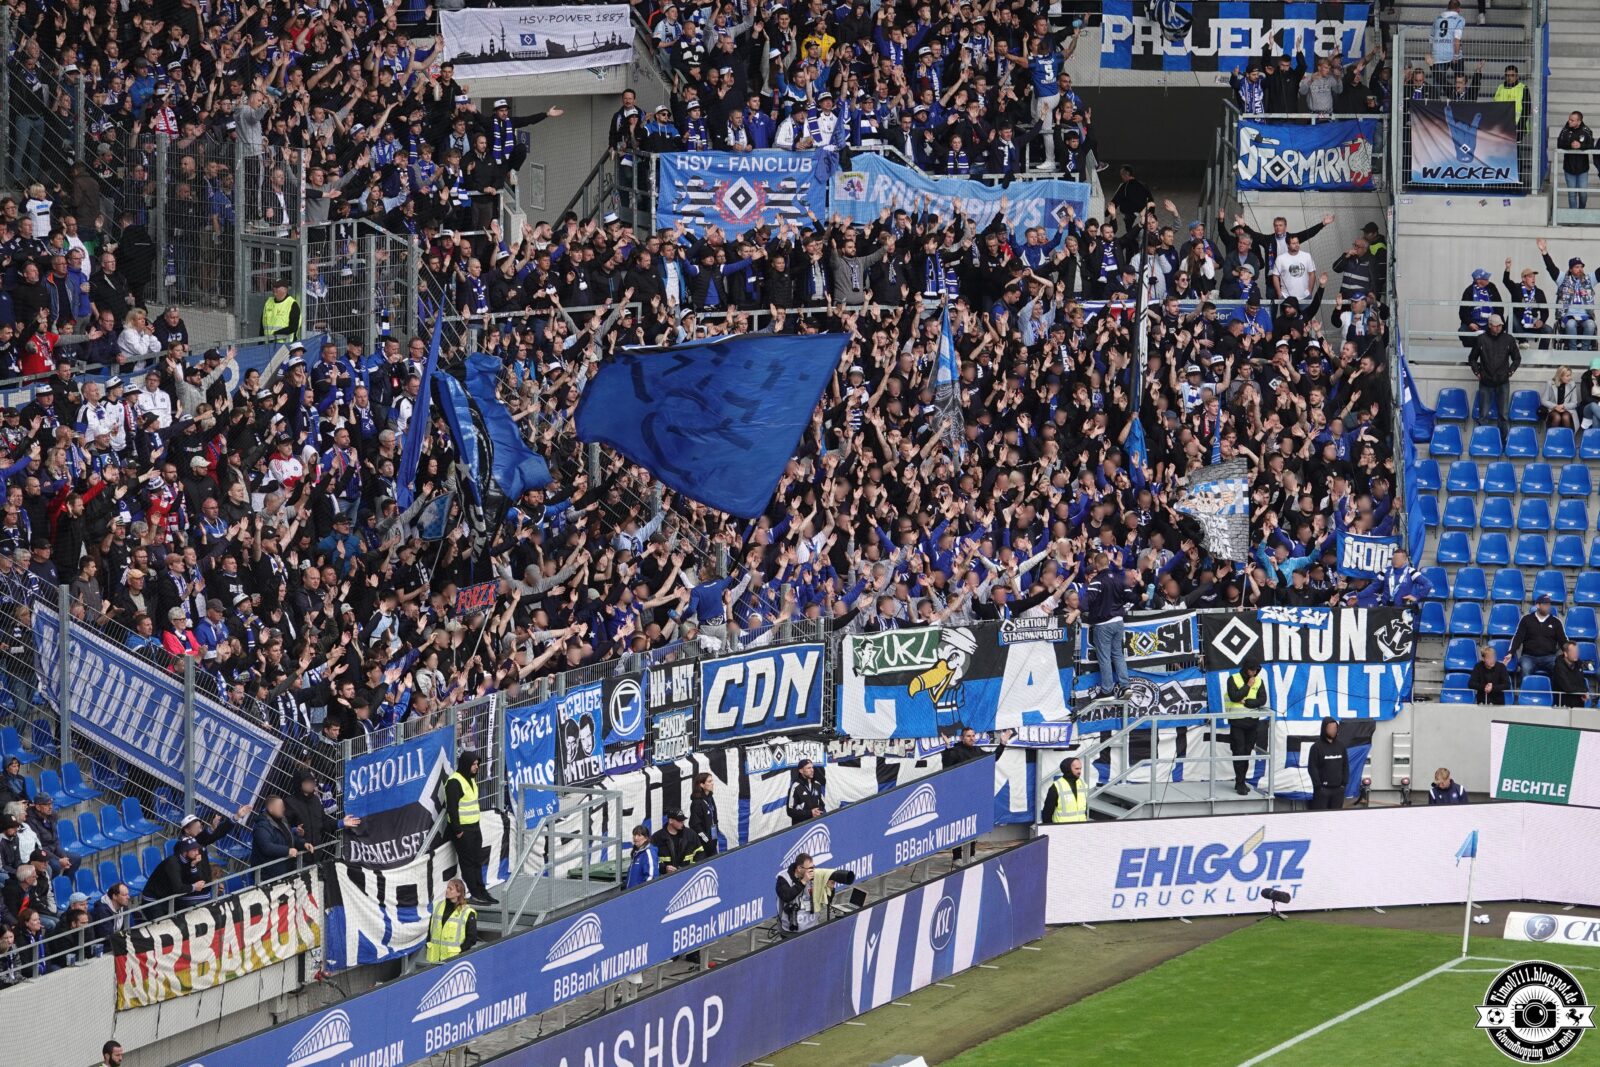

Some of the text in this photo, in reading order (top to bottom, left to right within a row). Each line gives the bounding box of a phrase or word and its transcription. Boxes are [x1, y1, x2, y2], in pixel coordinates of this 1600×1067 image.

[519, 12, 625, 24] HSV-POWER 1887
[1439, 20, 1448, 37] 9
[676, 155, 712, 171] HSV
[728, 156, 813, 173] FANCLUB
[1422, 166, 1511, 180] WACKEN
[348, 748, 427, 800] SCHOLLI
[1501, 778, 1567, 798] BECHTLE
[896, 813, 978, 865] BBBank WILDPARK
[1112, 884, 1302, 908] DRUCKLUT
[672, 896, 764, 953] BBBank WILDPARK
[553, 942, 649, 1003] BBBank WILDPARK
[425, 992, 528, 1054] BBBank WILDPARK
[558, 995, 723, 1067] SHOP
